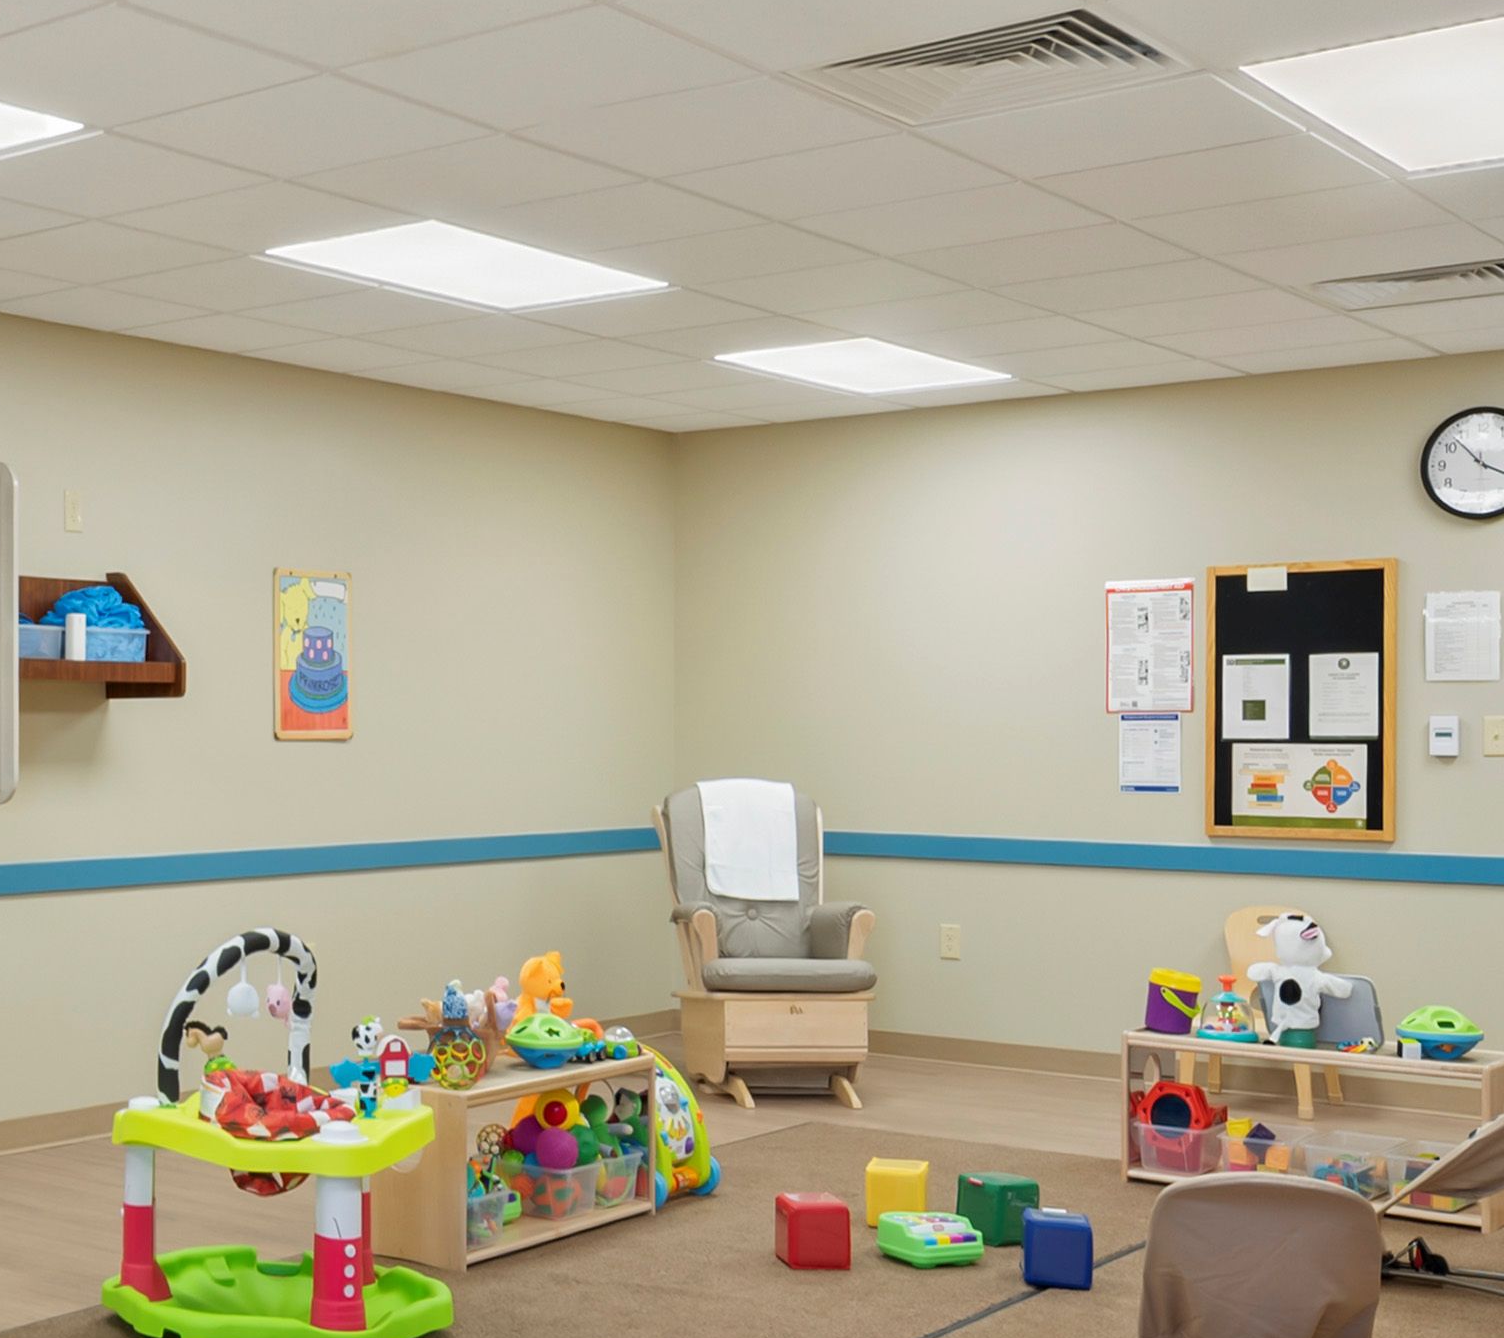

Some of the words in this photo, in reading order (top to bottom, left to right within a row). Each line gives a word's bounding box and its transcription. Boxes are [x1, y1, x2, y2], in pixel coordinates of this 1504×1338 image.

[1478, 422, 1490, 434] 12
[1445, 442, 1458, 454] 10
[1438, 460, 1447, 472] 9
[1444, 477, 1453, 489] 8
